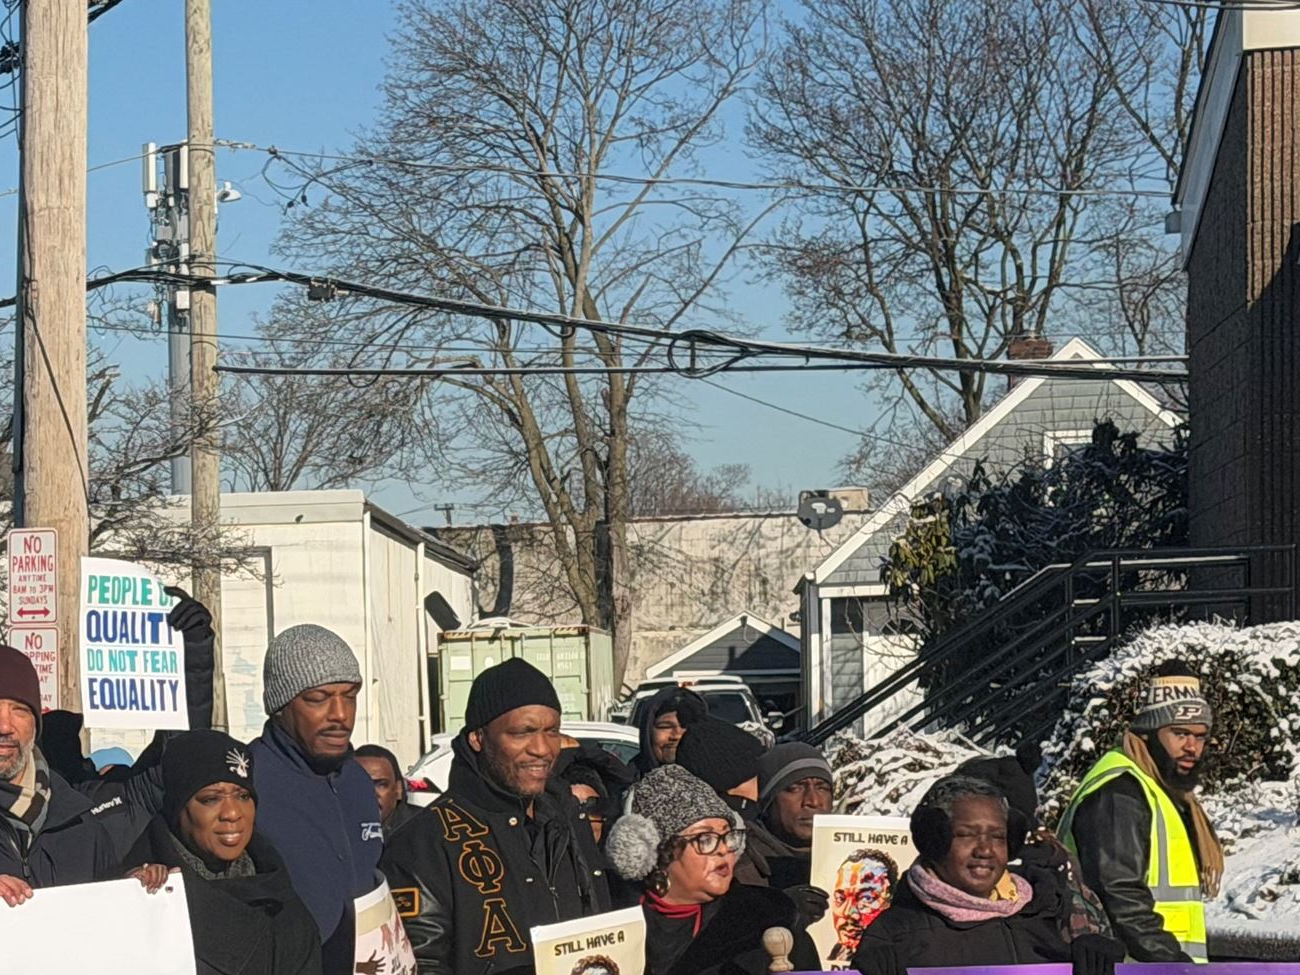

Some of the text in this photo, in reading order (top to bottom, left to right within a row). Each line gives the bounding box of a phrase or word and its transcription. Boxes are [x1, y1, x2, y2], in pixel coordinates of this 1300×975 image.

[23, 536, 42, 554] NO
[12, 556, 54, 573] PARKING
[87, 575, 153, 606] PEOPLE
[86, 609, 174, 645] QUALITY
[25, 635, 43, 650] NO
[86, 648, 178, 673] DO NOT FEAR
[87, 677, 179, 712] EQUALITY
[1174, 704, 1203, 720] P
[833, 832, 908, 845] STILL HAVE A
[554, 930, 625, 956] STILL HAVE A
